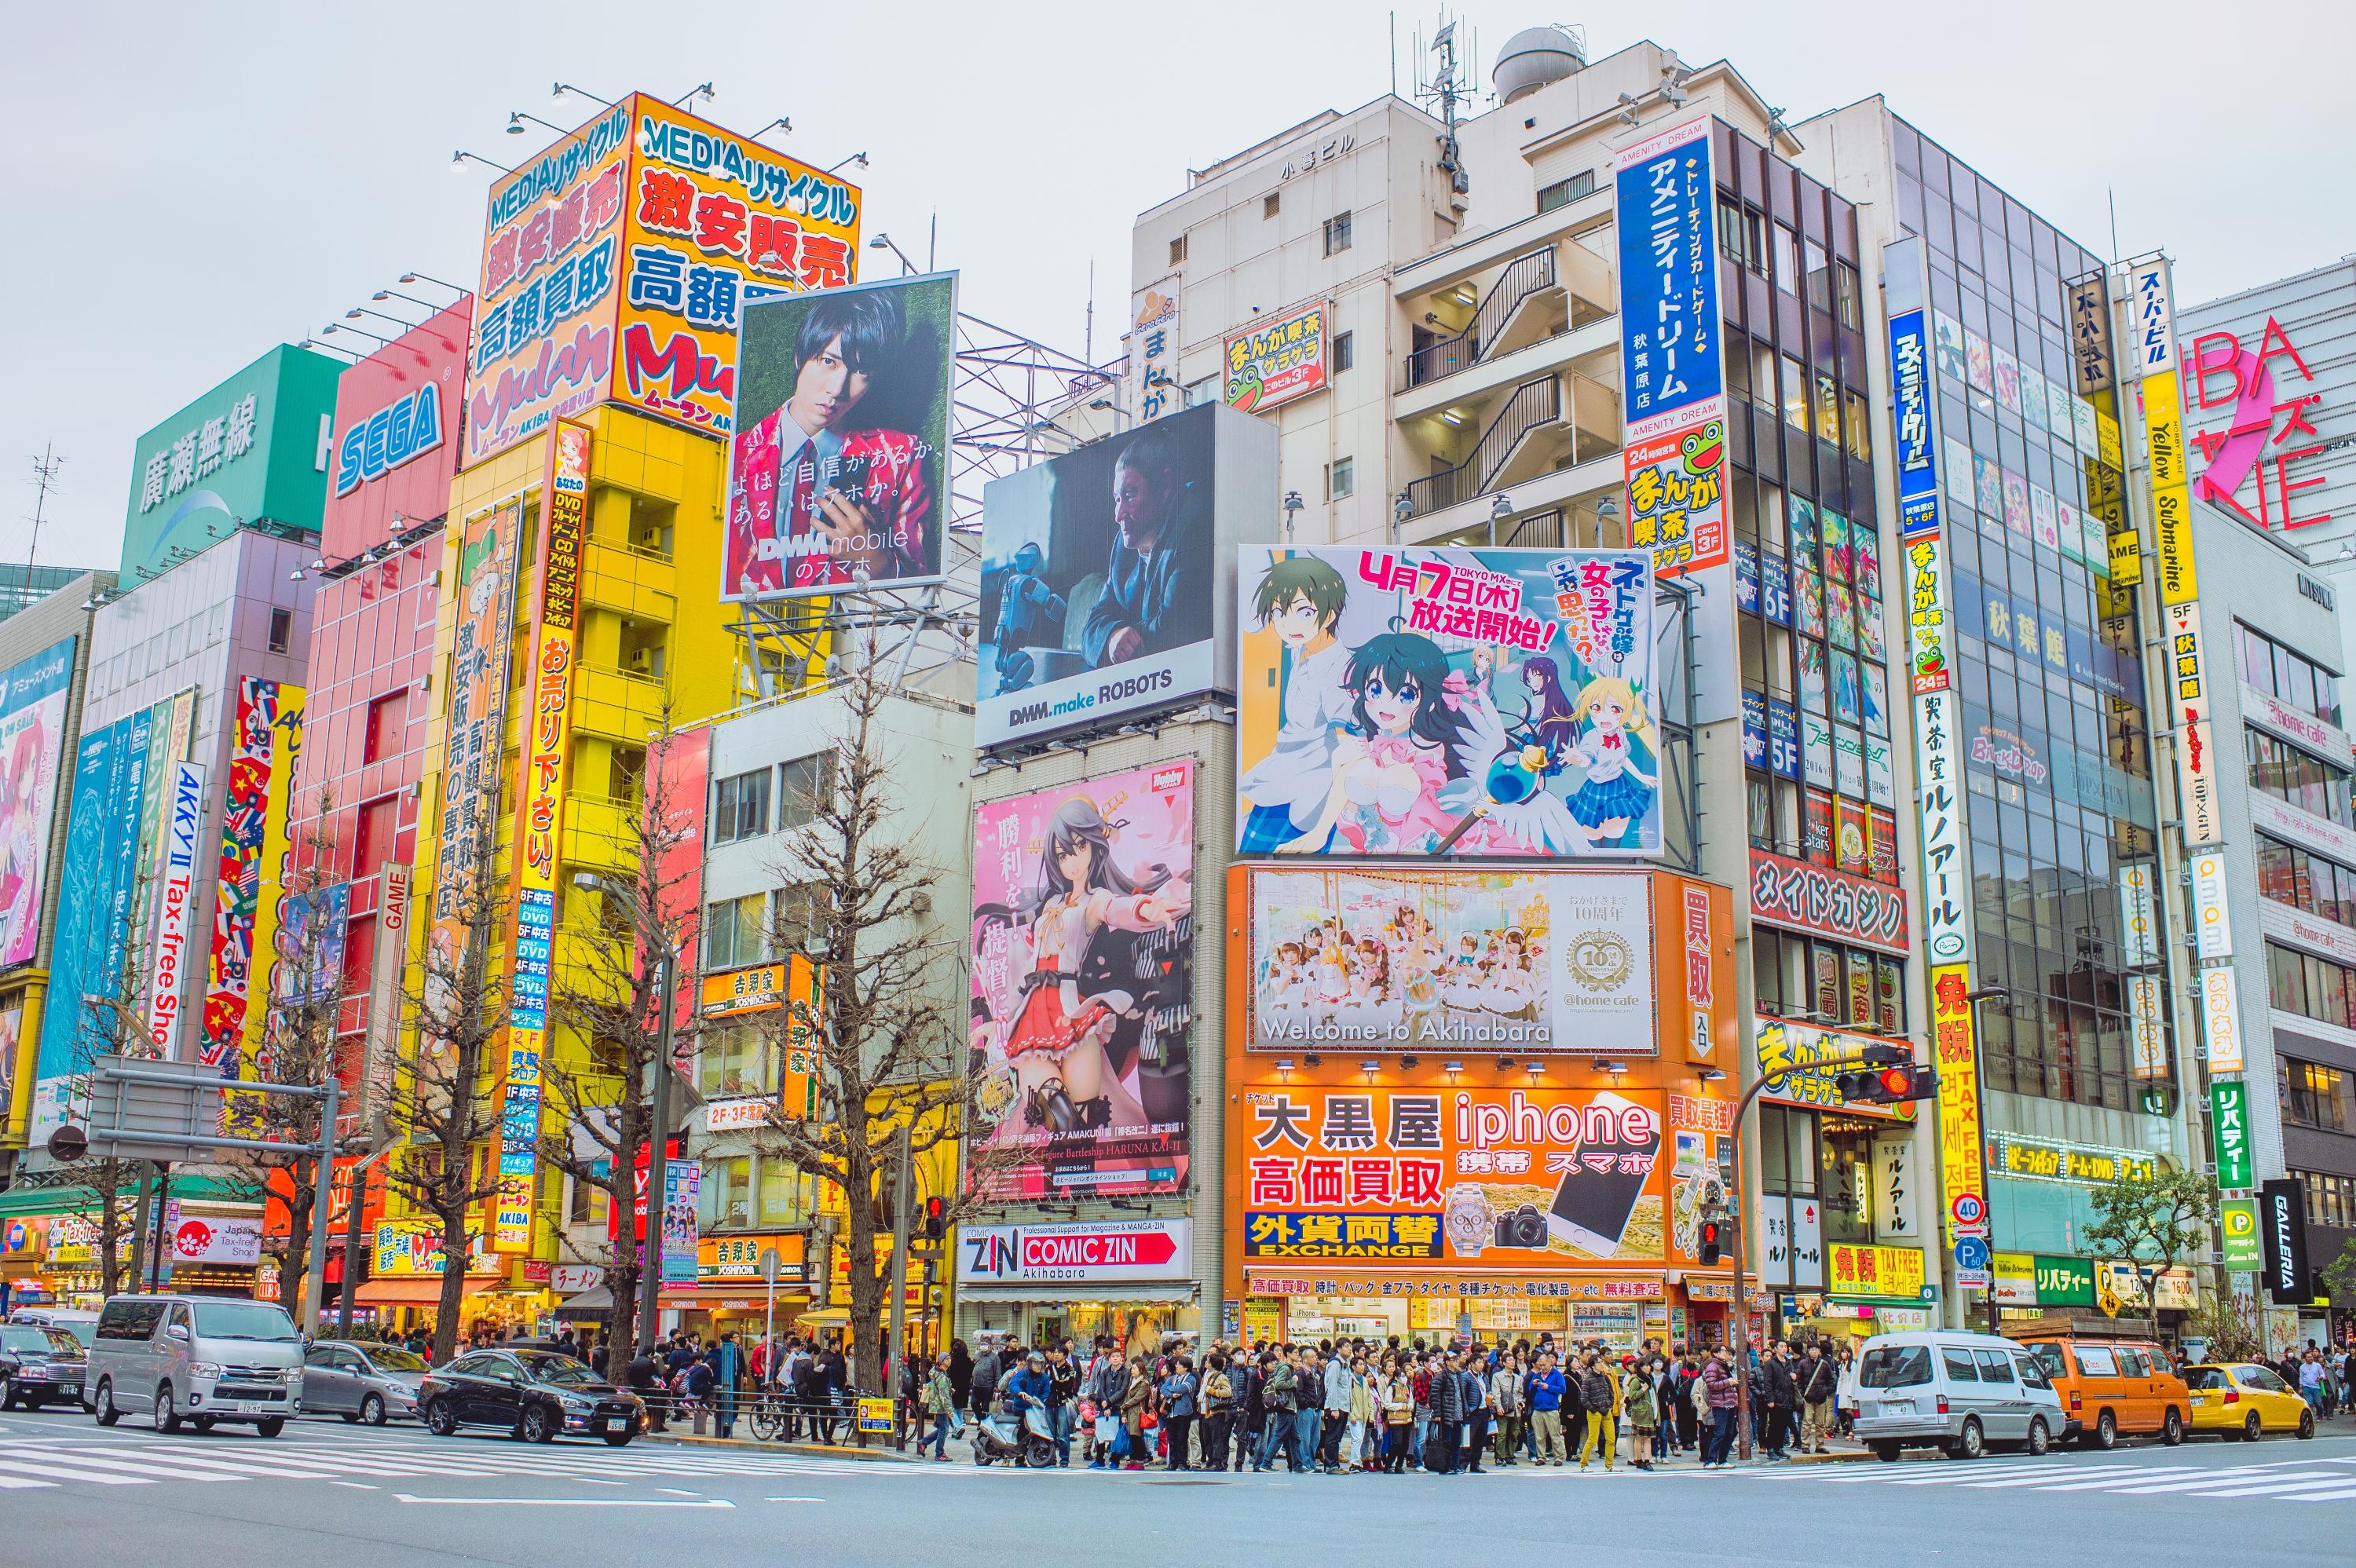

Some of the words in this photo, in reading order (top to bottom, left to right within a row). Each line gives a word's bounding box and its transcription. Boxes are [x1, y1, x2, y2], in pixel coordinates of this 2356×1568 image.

[1621, 141, 1662, 163] AMENITY
[1668, 124, 1703, 144] DREAM
[491, 107, 628, 234] MEDIAリサイクル
[642, 115, 856, 225] MEDIAリサイクル
[485, 162, 622, 299] 激安販売
[640, 166, 852, 287] 激安販売
[1688, 171, 1706, 342] トレーディングカードゲーム
[1648, 158, 1688, 400] アメニティードリーム
[477, 237, 616, 373] 高額買取
[2140, 272, 2167, 364] スーパービル
[1135, 310, 1176, 335] GeraGera
[1229, 311, 1321, 371] まんが喫茶
[1263, 338, 1319, 375] ゲラゲラ
[1143, 330, 1167, 422] まんが
[1633, 334, 1651, 409] 秋葉原店
[470, 325, 610, 454] Mulan
[643, 390, 712, 425] ムーラン
[1633, 415, 1675, 437] AMENITY
[1681, 403, 1717, 422] DREAM
[337, 381, 444, 499] SEGA
[519, 414, 550, 437] AKIBA
[1629, 443, 1676, 465] 24時間営業
[2151, 422, 2170, 480] Yellow
[556, 477, 584, 492] あなたの
[734, 441, 942, 496] よほど自信があるか、
[555, 495, 580, 510] DVD
[734, 479, 898, 525] あるいはアホか。
[1629, 465, 1721, 512] まんが
[552, 507, 580, 525] ブルーレイ
[552, 523, 579, 540] ゲーム
[1632, 510, 1688, 548] 喫茶
[555, 540, 573, 553] CD
[758, 532, 829, 562] DMM
[831, 527, 909, 554] mobile
[1697, 535, 1720, 552] 3F
[2159, 495, 2180, 593] Submarine
[548, 565, 576, 583] アニメ
[550, 552, 576, 568] アイドル
[1454, 566, 1487, 580] TOKYO
[1910, 541, 1937, 609] まんが
[547, 582, 573, 598] コミック
[548, 598, 572, 612] ホビー
[1765, 587, 1790, 618] 6F
[545, 612, 572, 628] フィギュア
[1581, 561, 1612, 655] 女の子じゃない
[1612, 560, 1646, 663] ネトゲの嫁は
[1912, 609, 1944, 627] 喫茶
[2173, 605, 2192, 619] 5F
[1410, 598, 1557, 652] 放送開始!
[1988, 600, 2065, 668] 秋葉館
[13, 657, 64, 695] アミューズメント館
[2082, 668, 2107, 685] Authorized
[2176, 634, 2201, 700] 秋葉館
[1009, 692, 1096, 727] DMM.make
[1099, 669, 1173, 704] ROBOTS
[1916, 678, 1936, 690] 24
[1923, 696, 1947, 780] 喫茶室
[2268, 700, 2304, 740] @home
[2307, 724, 2327, 747] cafe
[436, 620, 476, 922] 激安販売の専門店
[526, 637, 569, 879] お売り下さい!!
[1772, 740, 1797, 773] 5F
[1154, 769, 1184, 786] Hobby
[175, 767, 199, 850] AKKY
[1925, 786, 1960, 927] ルノアール
[386, 872, 406, 930] GAME
[521, 890, 533, 901] 6F
[534, 891, 553, 906] 中古
[1569, 896, 1628, 905] おかげさまで
[1754, 861, 1901, 941] メイドカジノ
[2200, 860, 2224, 953] amiami
[522, 912, 549, 923] DVD
[1575, 907, 1625, 922] 10周年
[157, 875, 190, 992] Tax-free
[518, 924, 531, 936] 5F
[532, 926, 550, 940] 中古
[1685, 890, 1712, 1006] 買取
[2293, 920, 2319, 943] @home
[2321, 931, 2335, 948] cafe
[519, 945, 547, 958] DVD
[529, 961, 547, 975] 中古
[1564, 994, 1610, 1006] @home
[1613, 995, 1639, 1006] cafe
[2208, 972, 2233, 1054] あみあみ
[1261, 1017, 1377, 1042] Welcome
[1387, 1021, 1411, 1041] to
[1418, 1018, 1550, 1043] Akihabara
[1697, 1015, 1707, 1047] 入口
[1935, 974, 1971, 1064] 免税
[1959, 1071, 1975, 1122] TAX
[1253, 1094, 1443, 1151] 大黒屋
[1456, 1090, 1651, 1149] iphone
[2219, 1089, 2244, 1182] リバティー
[502, 1156, 532, 1168] フィギュア
[1066, 1143, 1104, 1158] Battleship
[1107, 1143, 1148, 1155] HARUNA
[1458, 1151, 1529, 1175] 携帯
[1546, 1151, 1654, 1175] スマホ
[668, 1168, 699, 1179] 秋葉原
[1249, 1157, 1443, 1207] 高価買取
[499, 1194, 529, 1207] ムーラン
[1889, 1159, 1906, 1231] ルノアール
[1959, 1202, 1977, 1216] 40
[498, 1211, 528, 1225] AKIBA
[1057, 1225, 1079, 1234] Support
[1127, 1222, 1165, 1230] MANGA-ZIN
[1250, 1214, 1439, 1244] 外貨両替
[221, 1237, 255, 1246] Tax-free
[232, 1247, 254, 1257] Shop
[718, 1239, 758, 1263] 吉野家
[1025, 1237, 1099, 1264] COMIC
[1104, 1237, 1136, 1262] ZIN
[1259, 1245, 1429, 1256] EXCHANGE
[1963, 1245, 1974, 1265] P
[1971, 1257, 1981, 1266] 60
[2275, 1195, 2295, 1288] GALLERIA
[718, 1265, 755, 1275] YOSHINOYA
[1023, 1267, 1085, 1278] Akihabara
[1835, 1247, 1877, 1283] 免税
[1880, 1249, 1897, 1273] TAX
[1898, 1251, 1918, 1274] FREE
[557, 1272, 598, 1288] ラーメン
[1252, 1279, 1309, 1293] 高価買取
[1604, 1281, 1661, 1296] 無料査定
[2038, 1269, 2090, 1292] リバティー
[2171, 1281, 2190, 1294] 1600
[243, 1405, 261, 1413] 12-97
